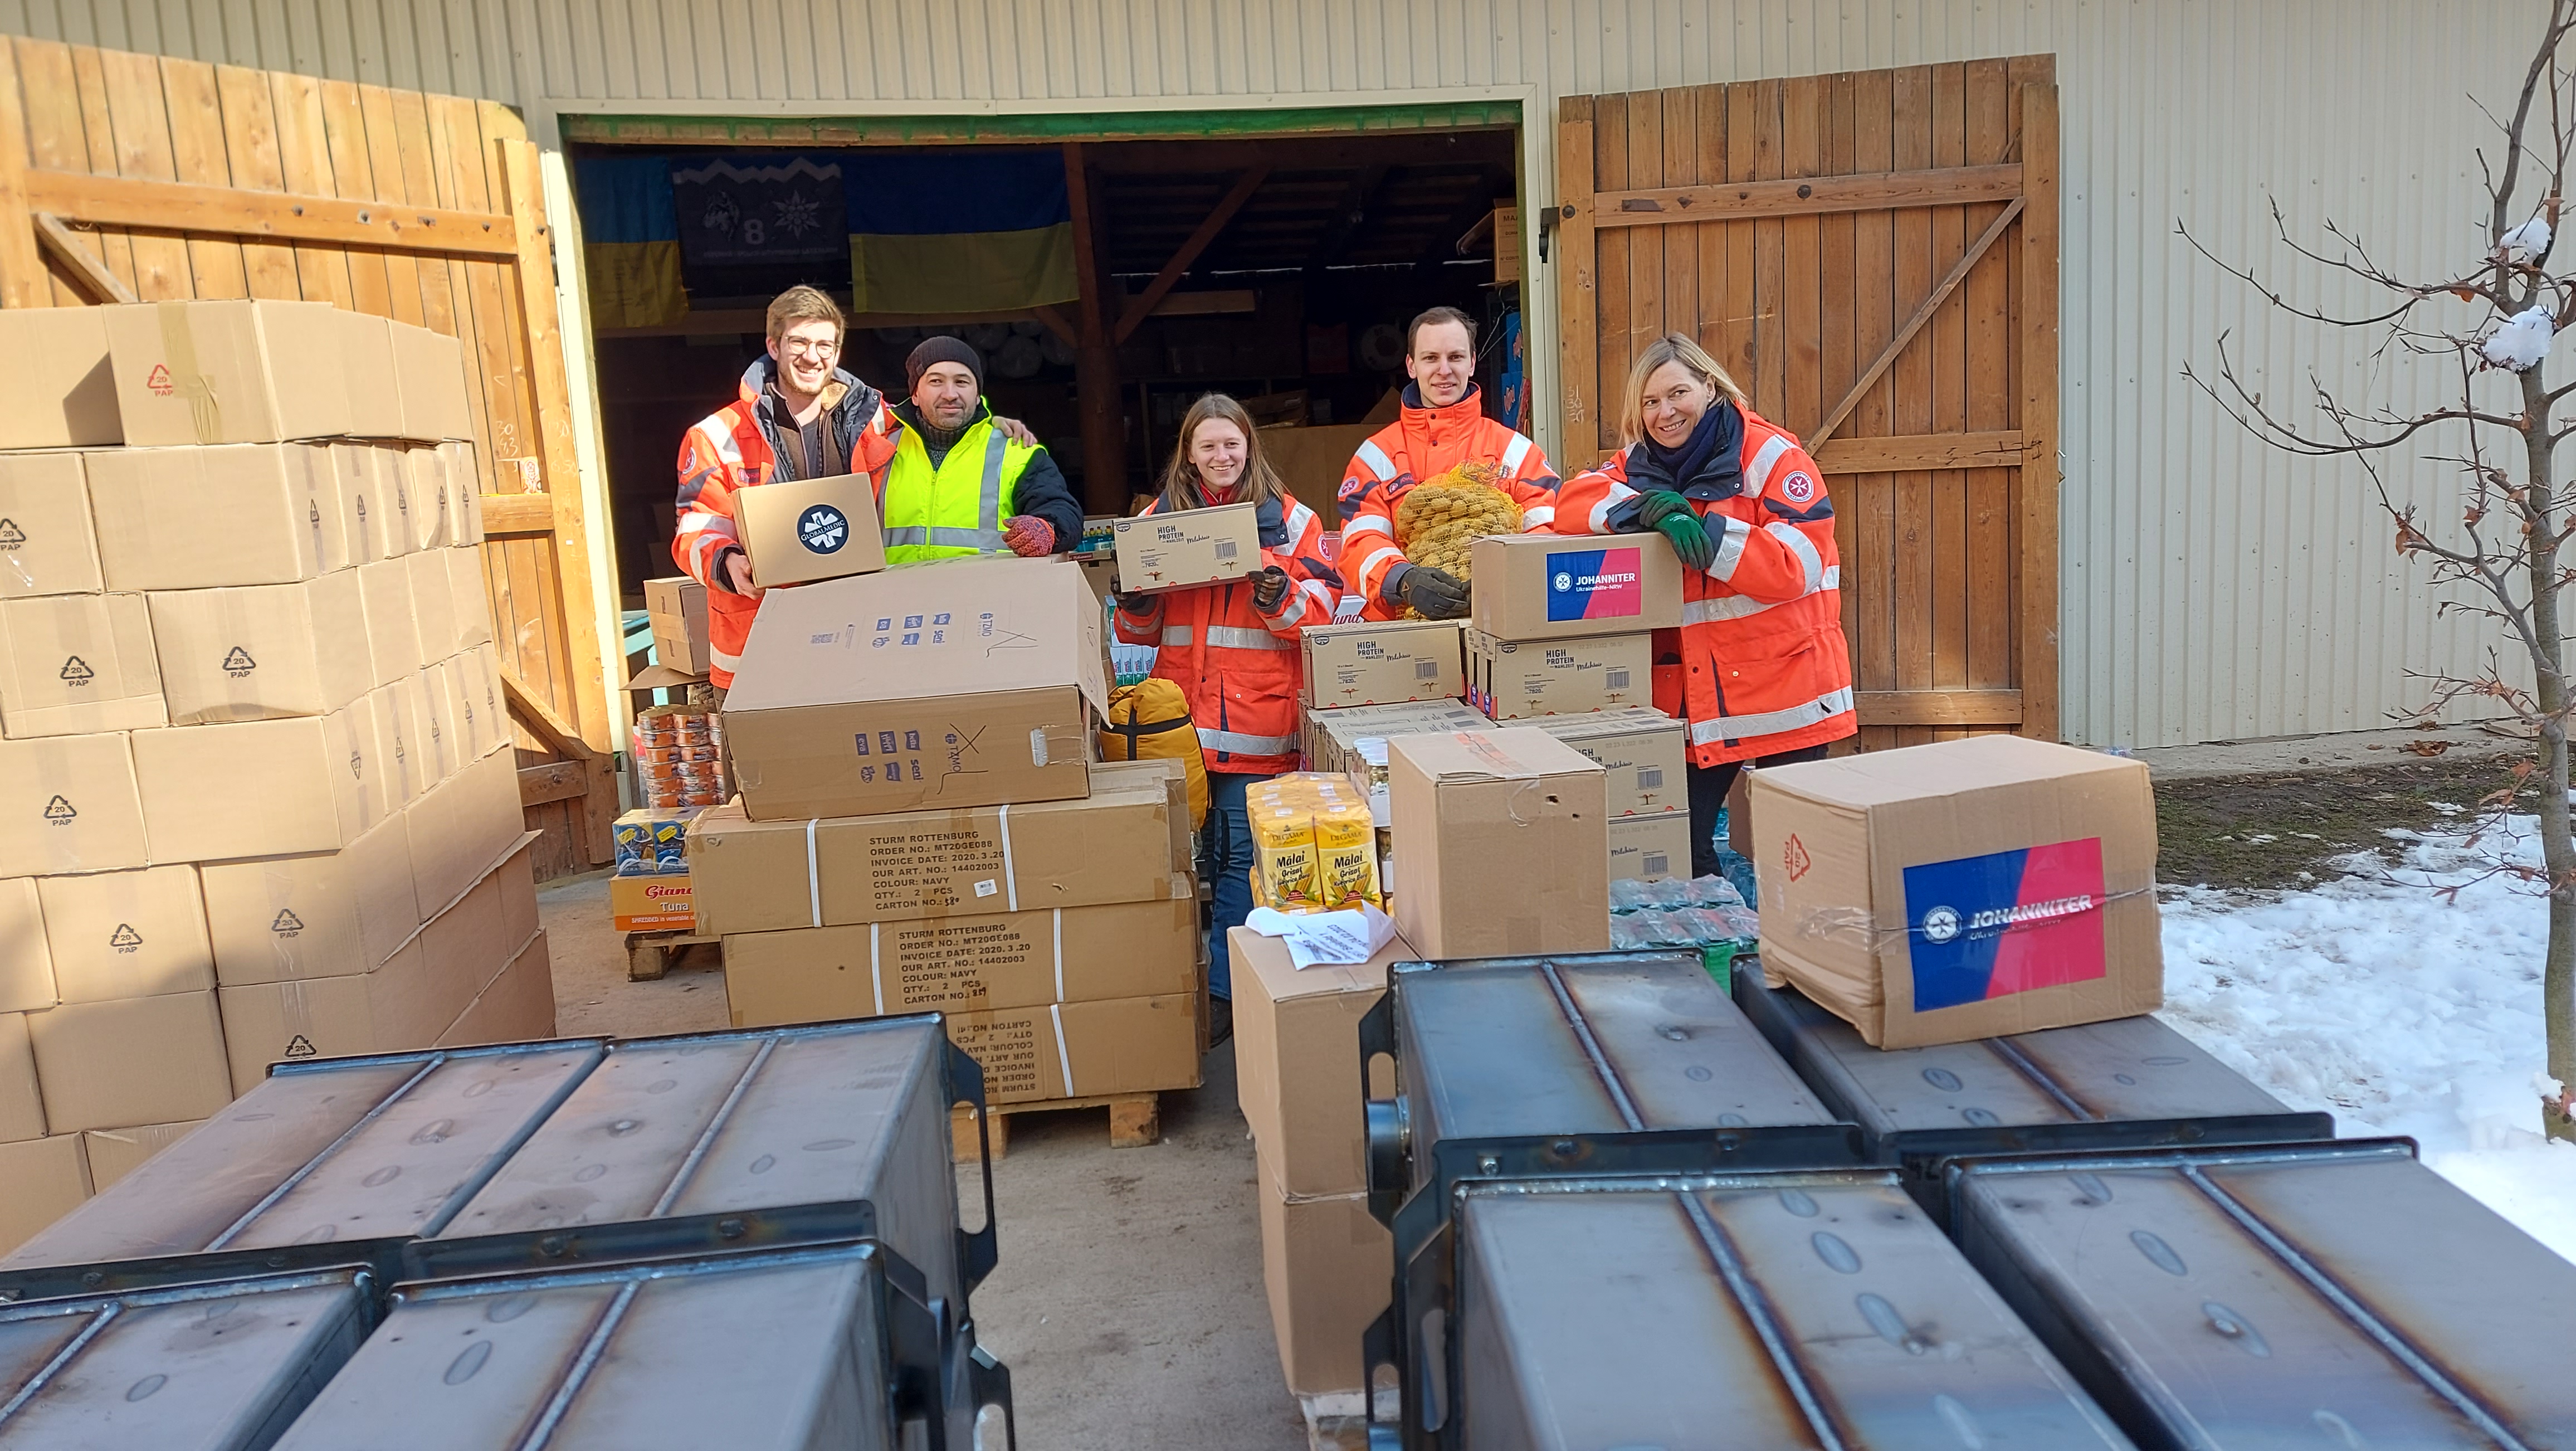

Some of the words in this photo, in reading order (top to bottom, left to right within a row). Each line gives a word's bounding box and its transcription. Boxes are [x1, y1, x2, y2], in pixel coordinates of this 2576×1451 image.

[743, 219, 765, 245] 8
[1157, 525, 1176, 534] HIGH
[1158, 532, 1184, 541] PROTEIN
[1576, 573, 1636, 586] JOHANNITER
[982, 620, 993, 637] TZMO
[933, 630, 945, 644] seni
[1357, 641, 1376, 649] HIGH
[1546, 649, 1566, 658] HIGH
[1546, 656, 1574, 665] PROTEIN
[1575, 748, 1593, 757] IGH
[910, 759, 924, 781] seni
[870, 836, 905, 845] STURM
[910, 831, 979, 843] ROTTENBURG
[870, 847, 905, 855] ORDER
[934, 840, 993, 851] MT20GE088
[871, 858, 913, 866] INVOICE
[918, 855, 947, 864] DATE:
[1276, 850, 1305, 869] Mălai
[1334, 850, 1363, 869] Mălai
[1796, 852, 1801, 868] 20
[899, 868, 921, 876] ART.
[952, 863, 999, 872] 14402003
[874, 879, 918, 888] COLOUR:
[923, 877, 949, 885] NAVY
[875, 891, 901, 899] QTY.:
[660, 902, 689, 912] Tuna
[876, 900, 917, 910] CARTON
[1970, 894, 2093, 929] JOHANNITER
[899, 930, 934, 939] STURM
[939, 924, 1006, 936] ROTTENBURG
[900, 941, 934, 950] ORDER
[963, 933, 1020, 944] MT20GE088
[901, 951, 942, 961] INVOICE
[947, 948, 975, 957] DATE:
[928, 961, 950, 970] ART.
[978, 956, 1024, 965] 14402003
[902, 973, 947, 982] COLOUR:
[950, 970, 977, 978] NAVY
[904, 985, 929, 994] QTY.:
[962, 980, 980, 989] PCS
[905, 994, 945, 1004] CARTON
[992, 1020, 1032, 1030] CARTON
[990, 1041, 1033, 1051] COLOUR:
[987, 1054, 1009, 1063] ART.
[1013, 1052, 1034, 1060] OUR
[995, 1063, 1035, 1072] INVOICE
[1002, 1073, 1035, 1082] ORDER
[1002, 1083, 1036, 1093] STURM
